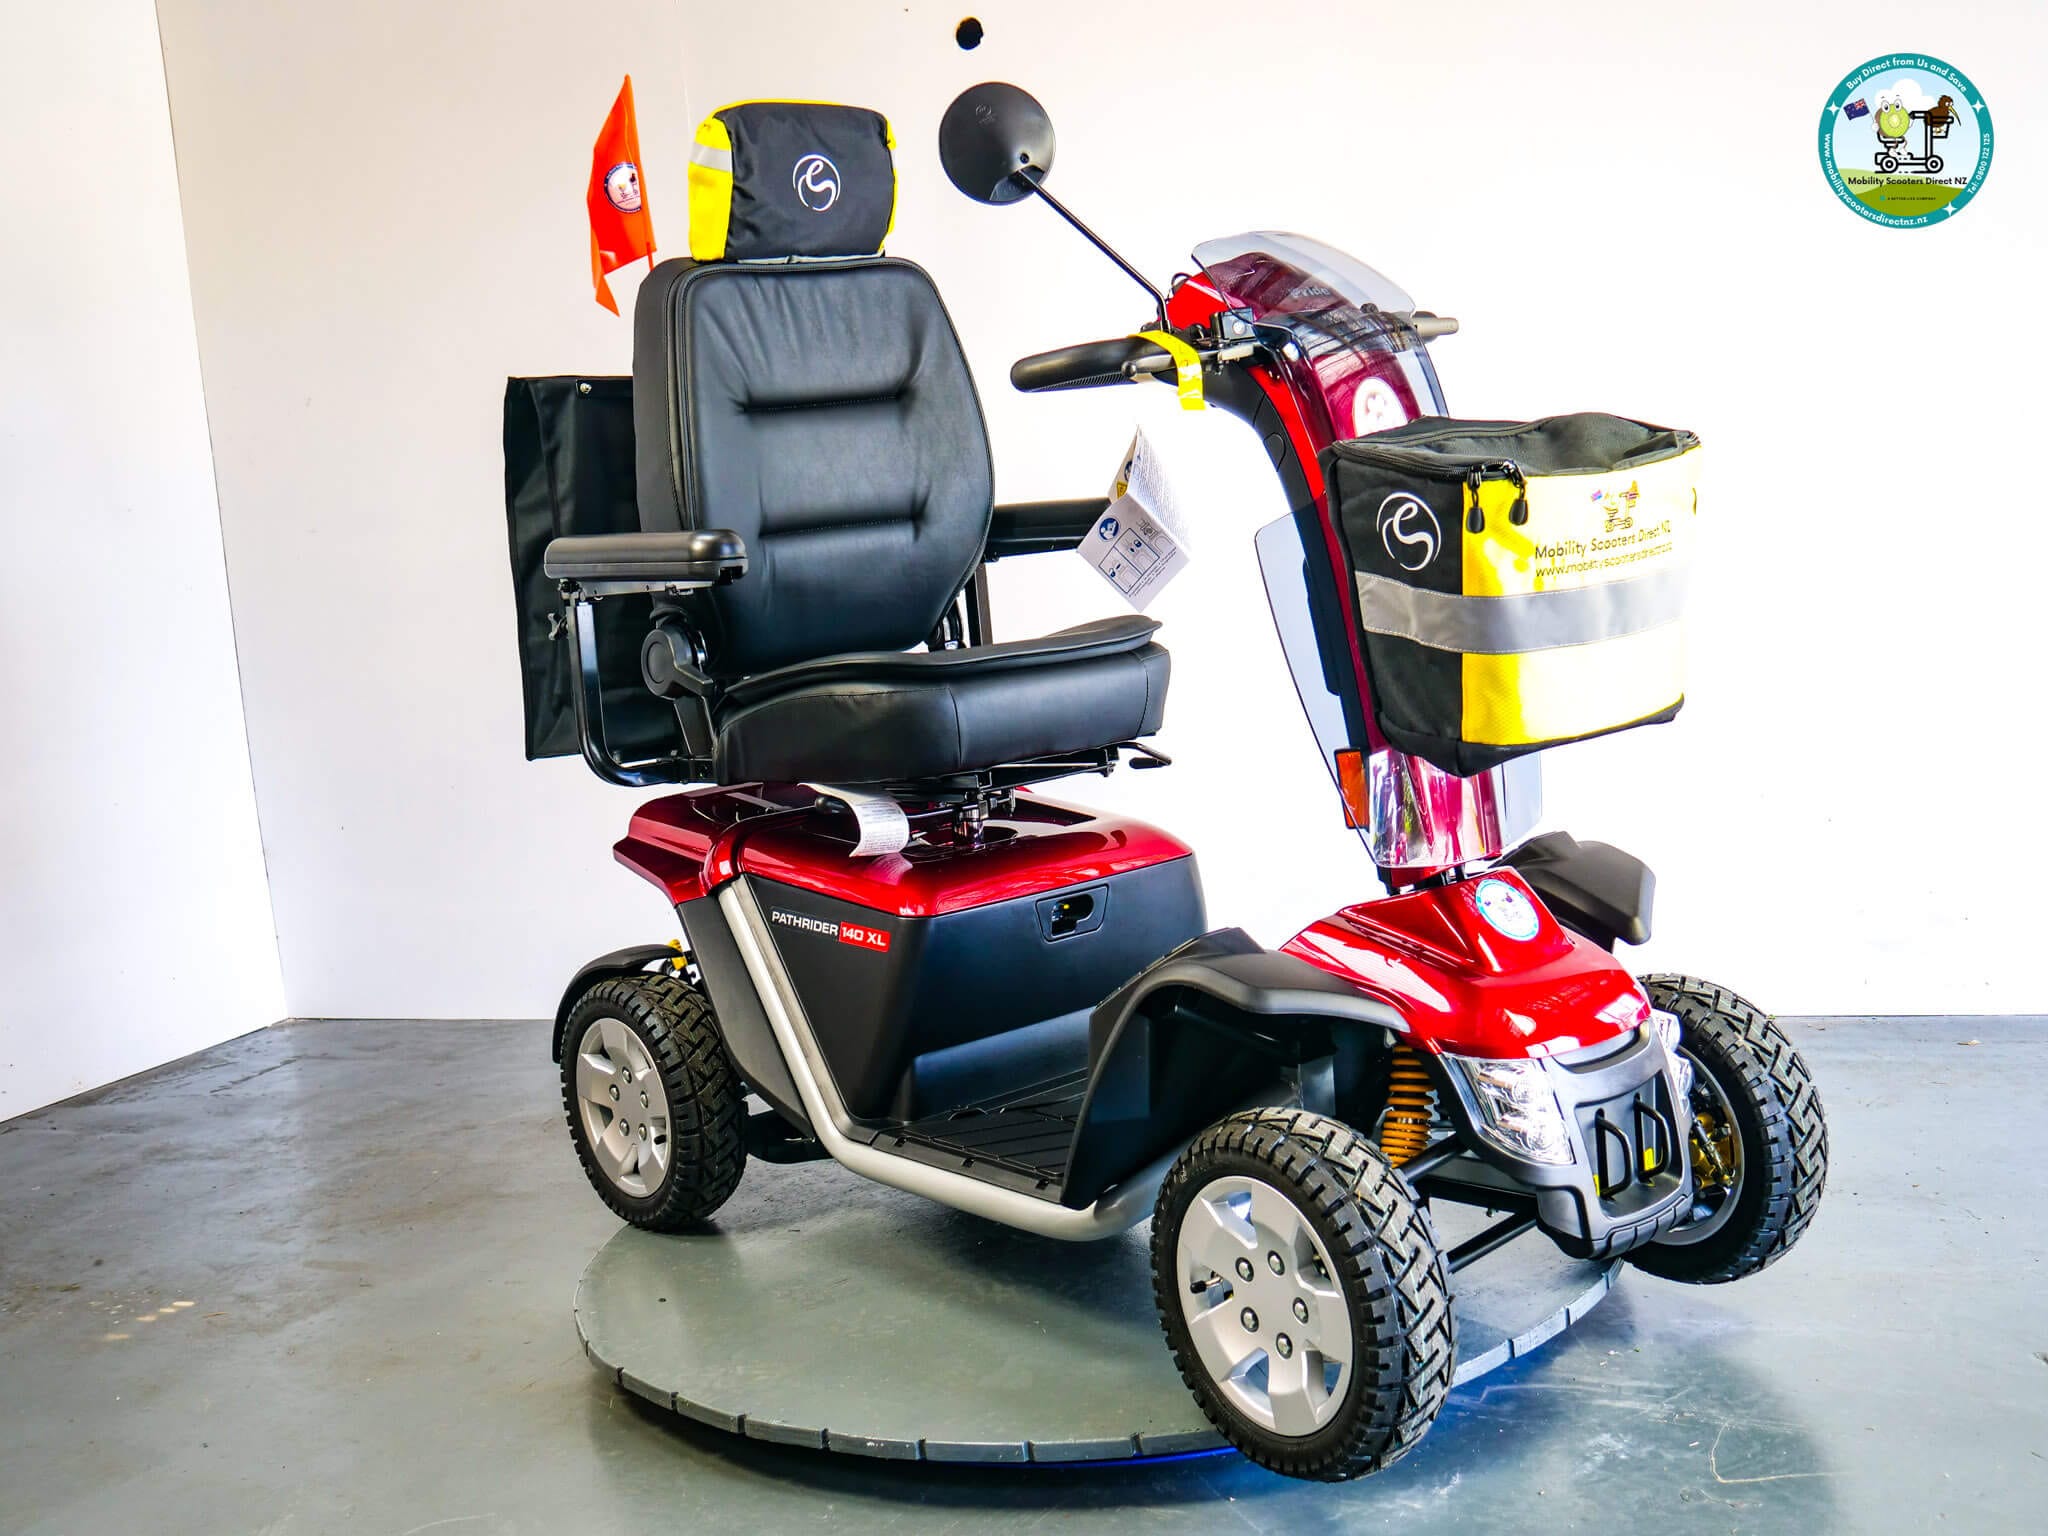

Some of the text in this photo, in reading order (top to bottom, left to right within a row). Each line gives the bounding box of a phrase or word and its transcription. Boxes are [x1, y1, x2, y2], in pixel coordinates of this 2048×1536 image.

[1535, 542, 1587, 559] Mobility
[1590, 534, 1636, 551] Scooters
[1637, 527, 1660, 542] Direct
[771, 911, 886, 947] PATHRIDER 140 XL
